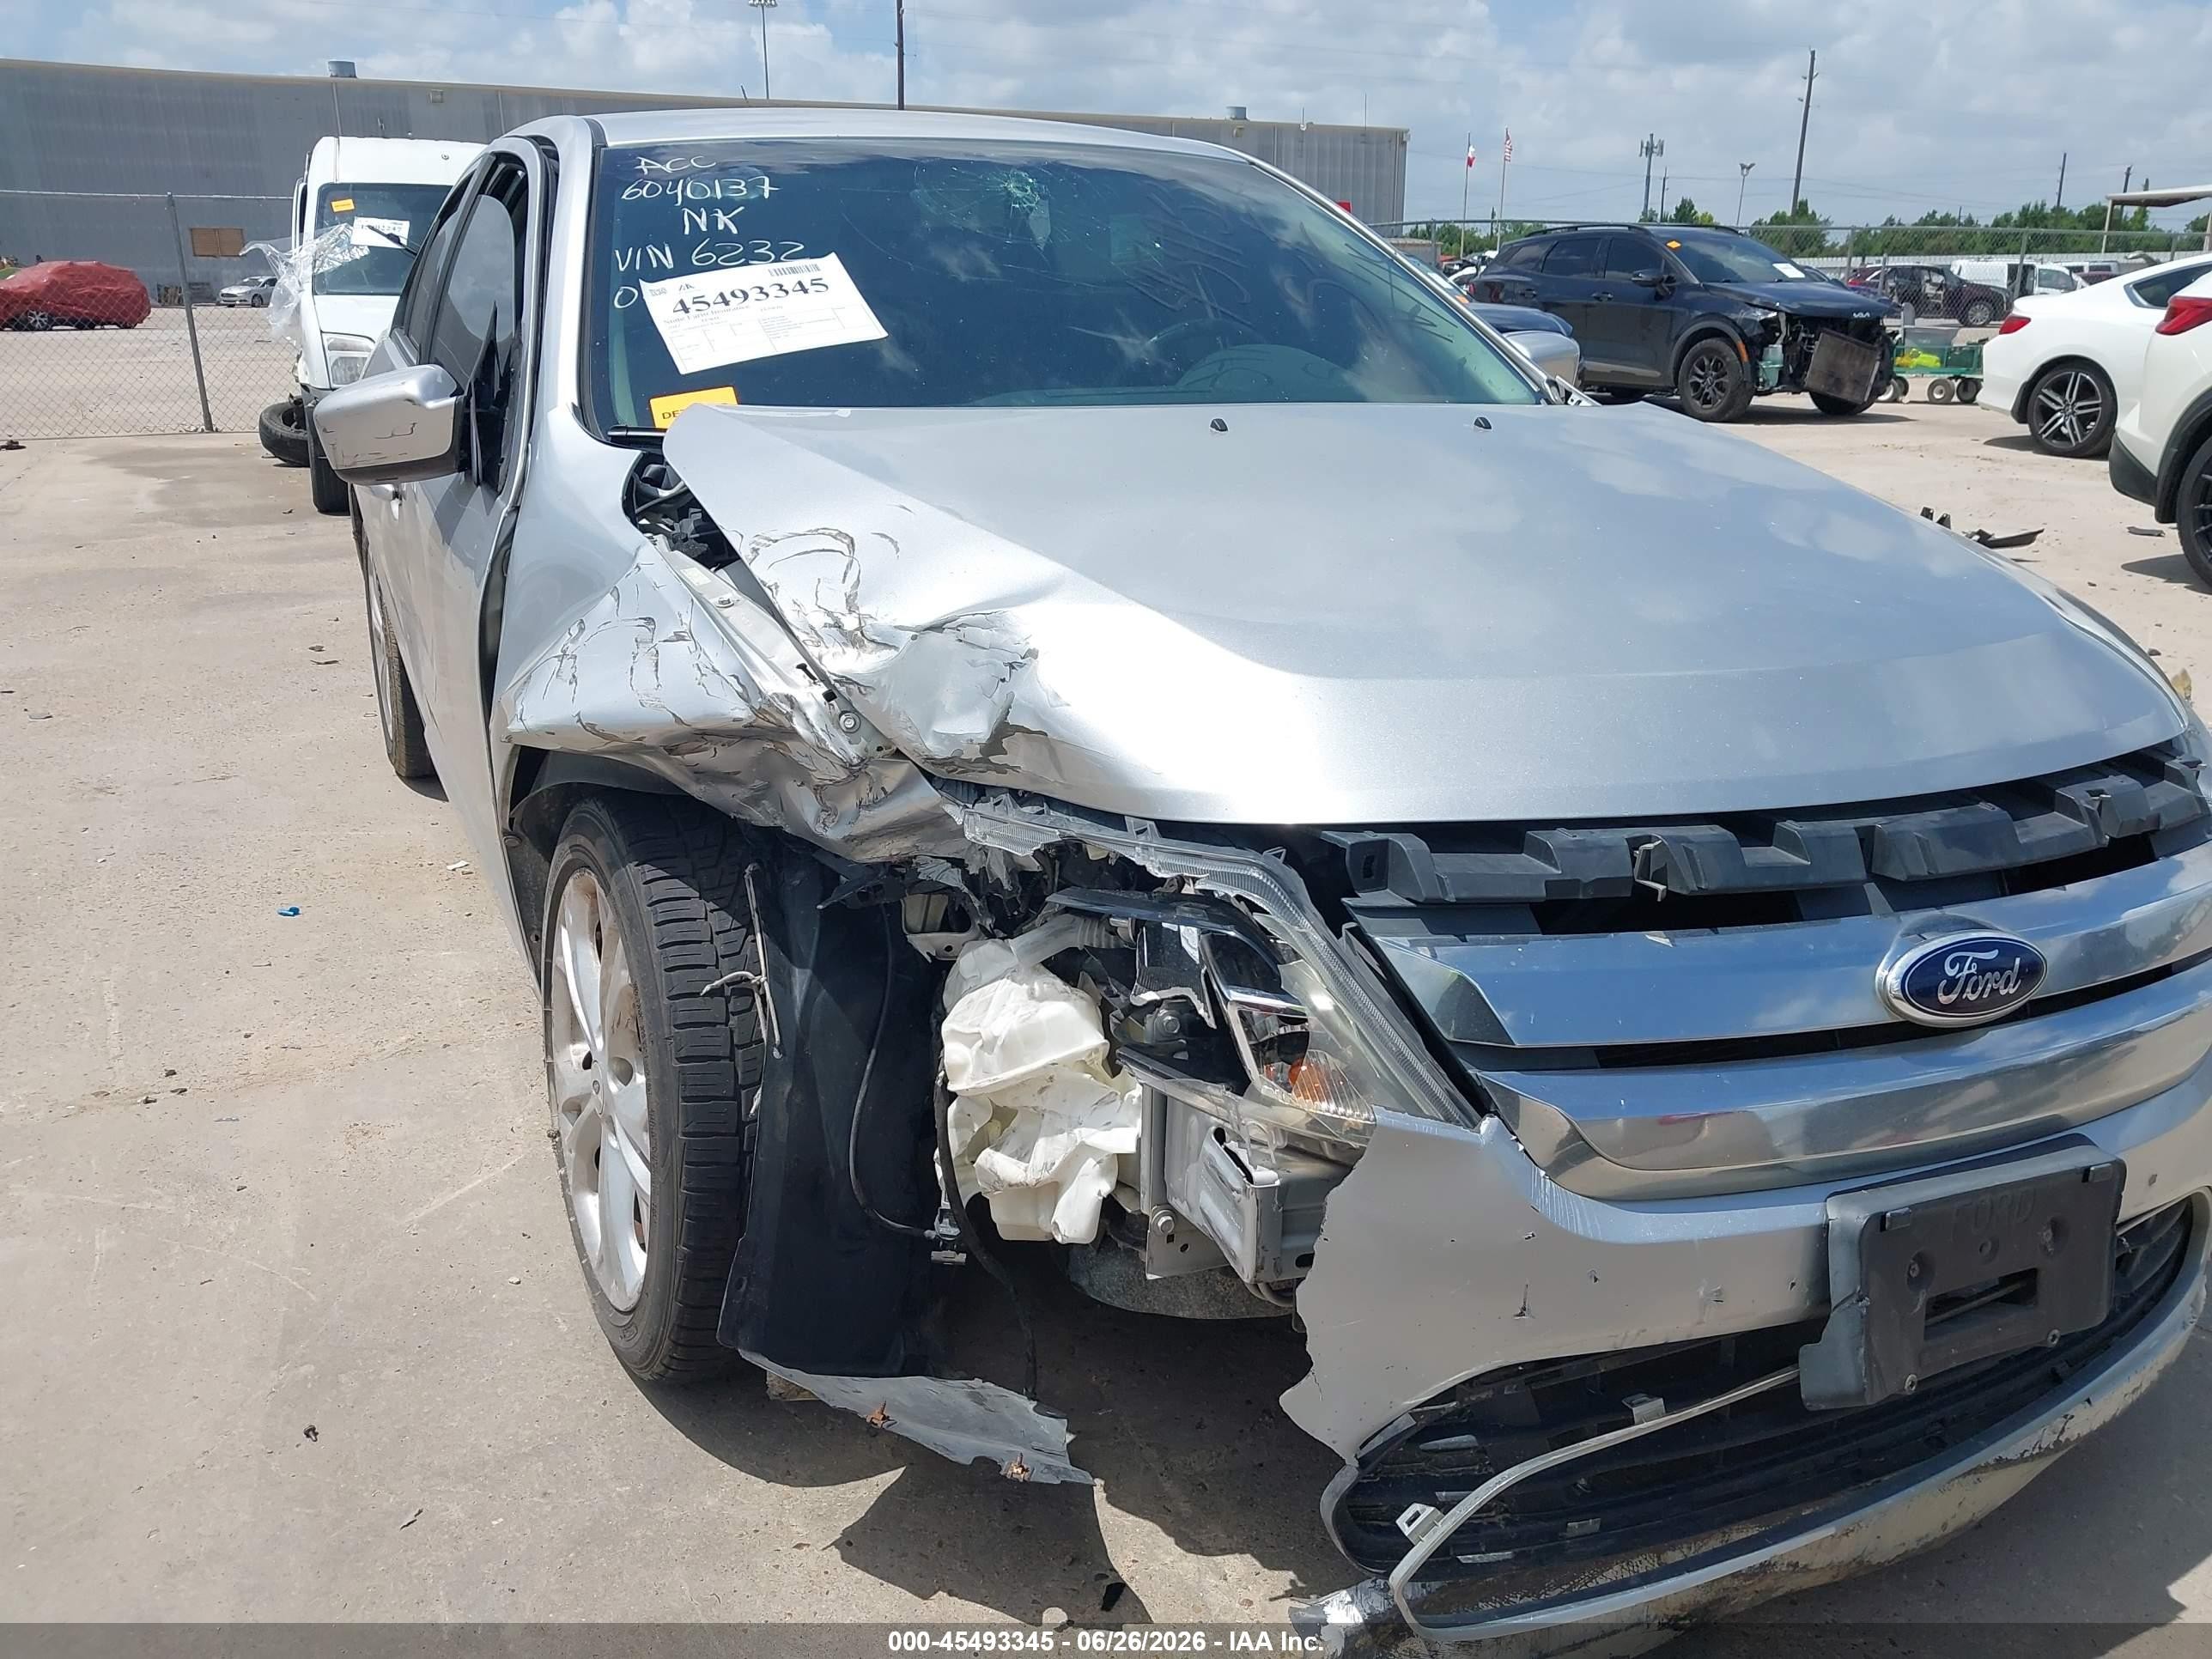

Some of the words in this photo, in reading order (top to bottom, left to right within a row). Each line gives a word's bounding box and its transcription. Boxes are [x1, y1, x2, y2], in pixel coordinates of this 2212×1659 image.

[634, 155, 716, 175] ACC
[621, 175, 783, 206] 6040137
[614, 241, 674, 271] VIN
[691, 238, 805, 266] 6232
[672, 277, 830, 314] 45493345
[1937, 949, 2021, 1005] Ford
